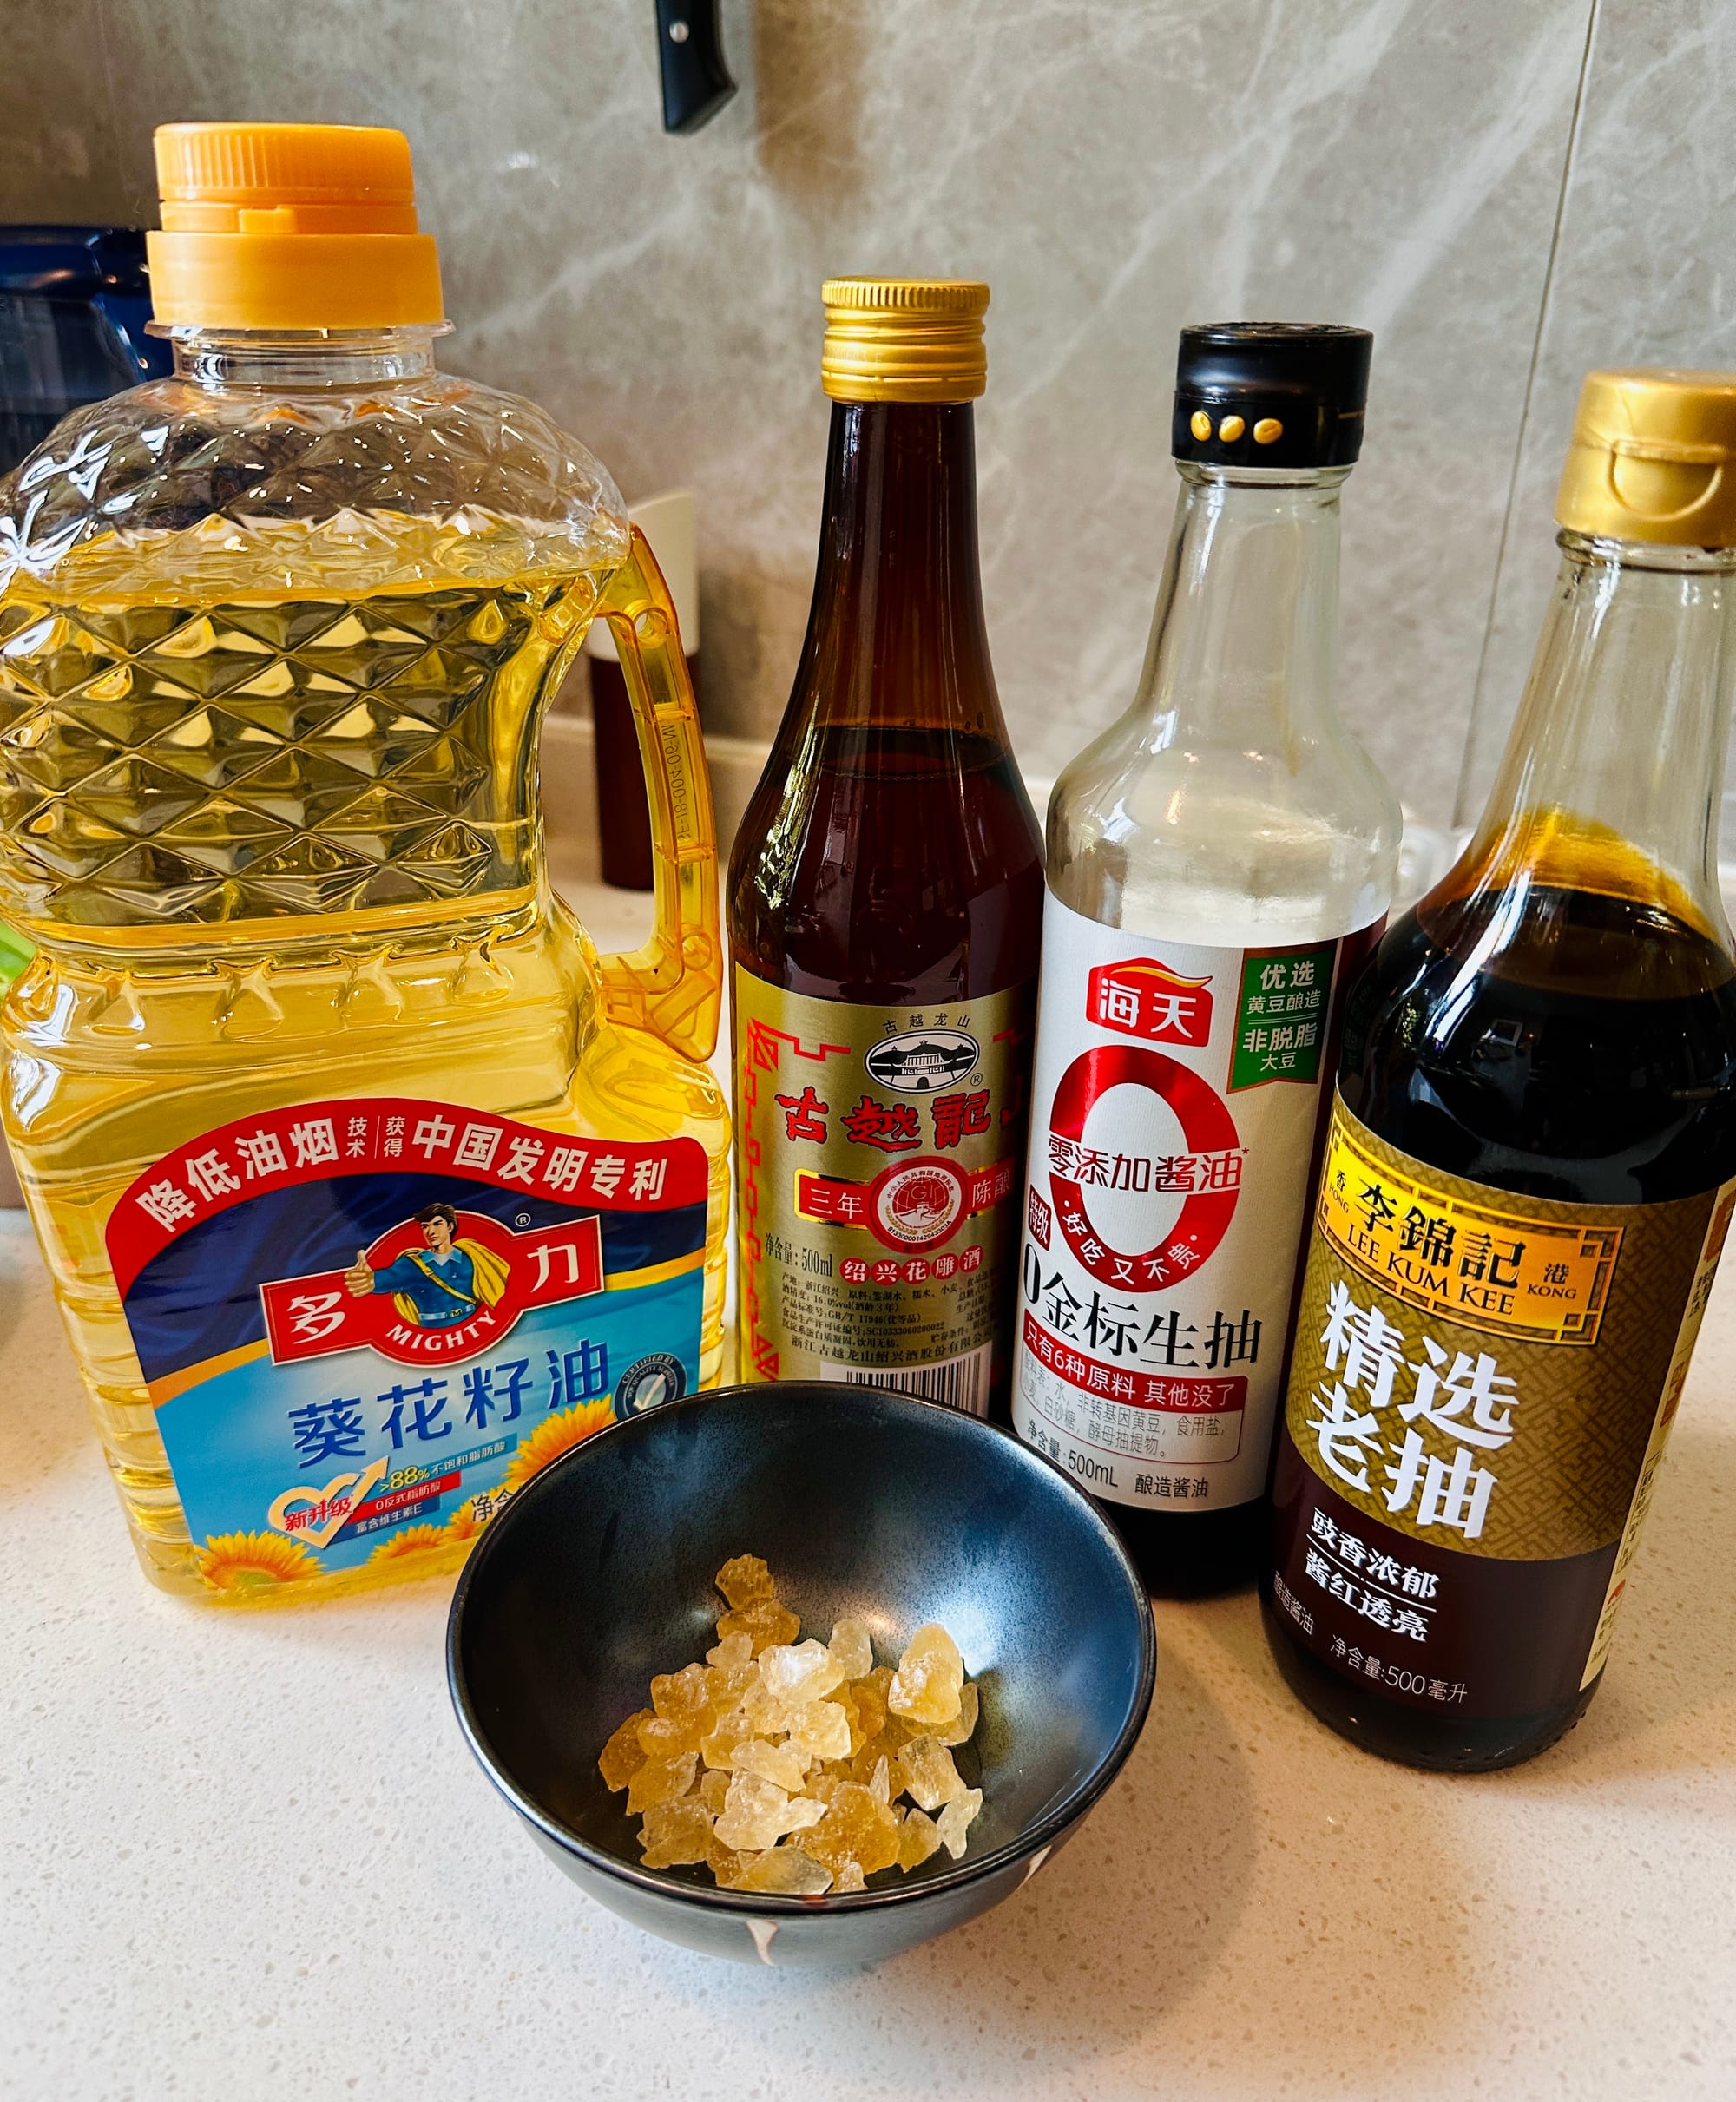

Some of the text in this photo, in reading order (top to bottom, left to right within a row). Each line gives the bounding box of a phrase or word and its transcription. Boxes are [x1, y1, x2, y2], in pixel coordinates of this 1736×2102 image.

[1260, 960, 1315, 990] 优选
[1099, 978, 1196, 1038] 海天
[1246, 989, 1321, 1015] 黄豆酿造
[882, 1013, 970, 1035] 古越龙山
[1242, 1022, 1318, 1053] 非脱脂
[1259, 1051, 1297, 1072] 大豆
[135, 1114, 669, 1232] 降低油烟 技术 获得 中国发明专利
[1335, 1170, 1347, 1193] 香
[808, 1186, 865, 1219] 三年
[1328, 1186, 1350, 1214] HONG
[1354, 1178, 1526, 1290] 李錦記
[844, 1246, 982, 1283] 绍兴花雕酒
[1346, 1223, 1516, 1317] LEE KUM KEE
[1543, 1263, 1570, 1285] 港
[286, 1243, 580, 1344] 多 力
[1526, 1284, 1577, 1300] KONG
[385, 1310, 497, 1351] MIGHTY
[622, 1354, 663, 1383] CERTIFIED
[663, 1355, 675, 1365] BY
[1026, 1319, 1235, 1408] 只有6种原料 其他没了
[1319, 1279, 1520, 1450] 精选
[287, 1338, 608, 1469] 葵花籽油
[1305, 1381, 1498, 1540] 老抽
[1134, 1473, 1208, 1498] 酿造酱油
[285, 1494, 353, 1532] 新升级
[356, 1502, 423, 1534] 富含维生素E
[1311, 1507, 1441, 1599] 豉香浓郁
[1305, 1547, 1429, 1643] 酱红透亮
